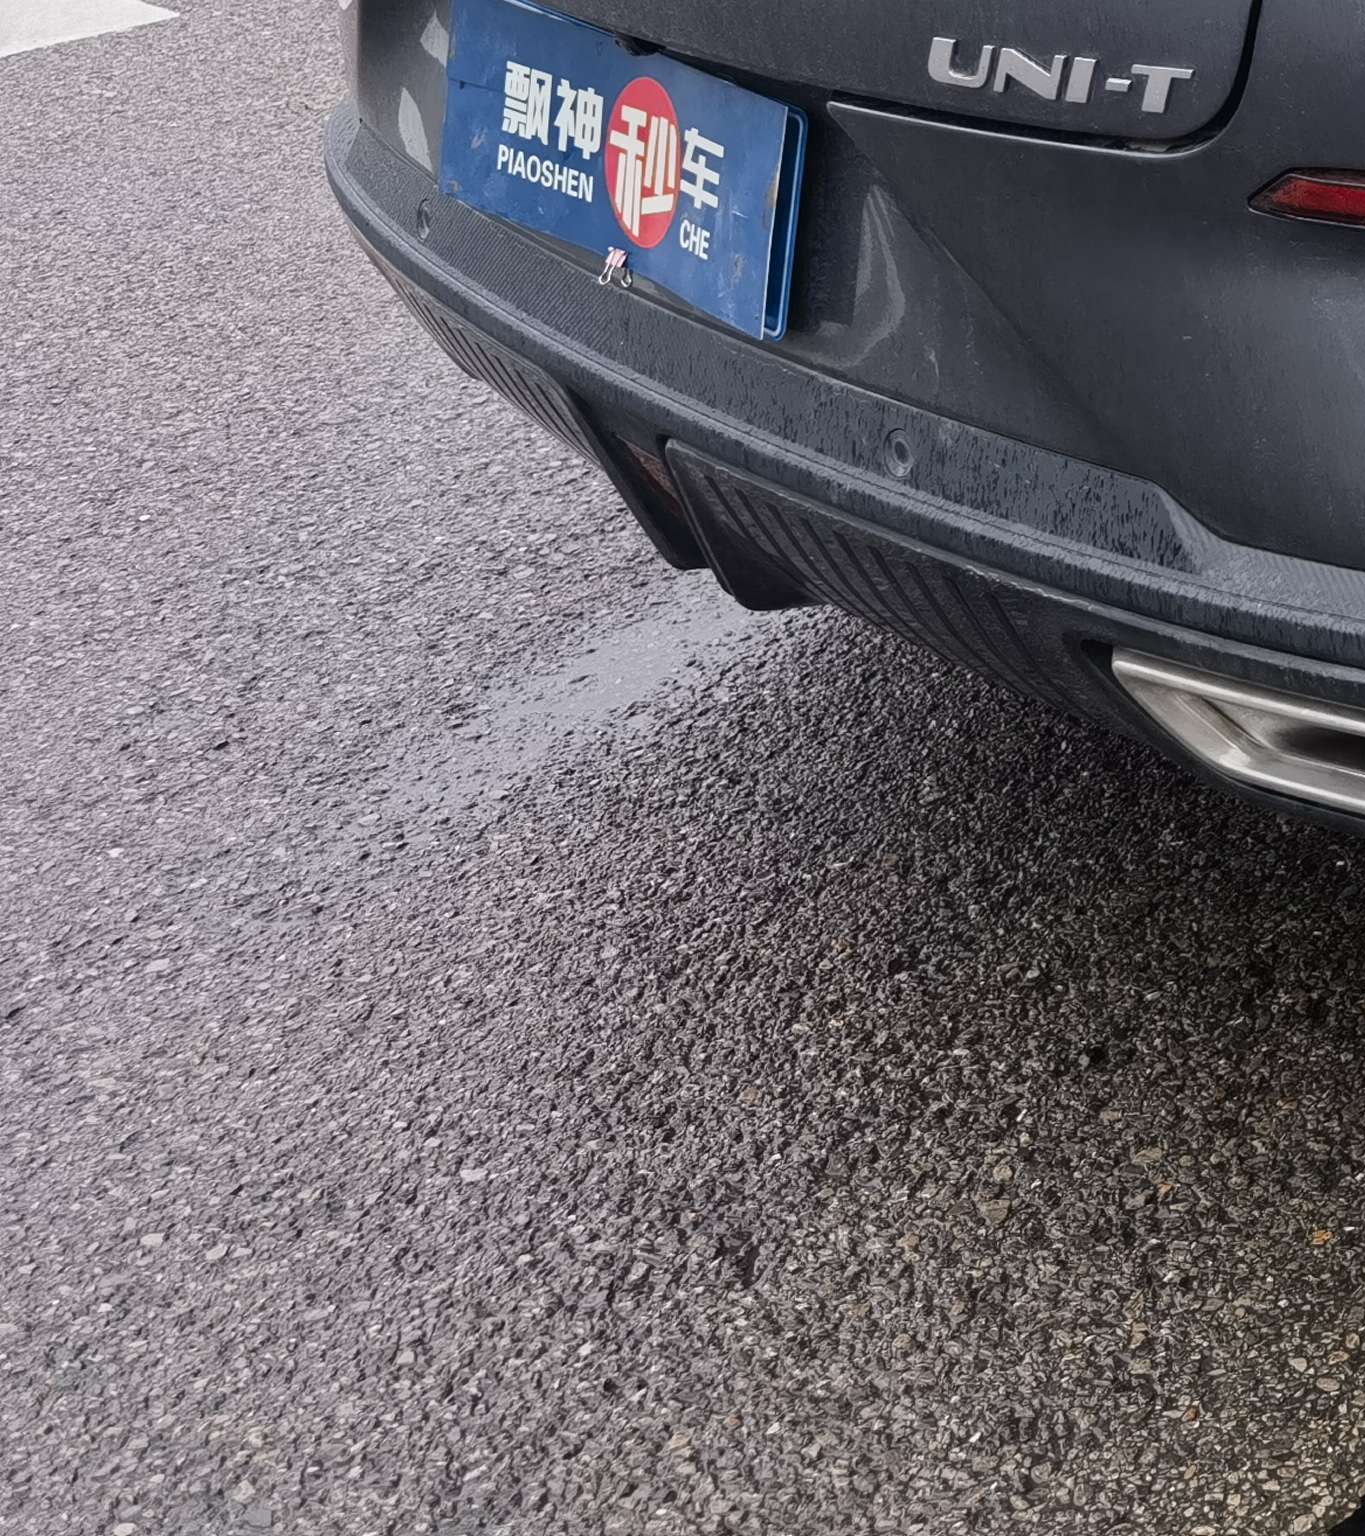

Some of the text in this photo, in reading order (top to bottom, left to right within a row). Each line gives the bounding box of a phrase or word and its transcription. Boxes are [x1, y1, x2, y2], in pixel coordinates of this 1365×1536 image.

[928, 37, 1196, 114] UNI-T
[497, 144, 711, 260] PIAOSHEN CHE
[502, 61, 724, 237] 飘神秒车
